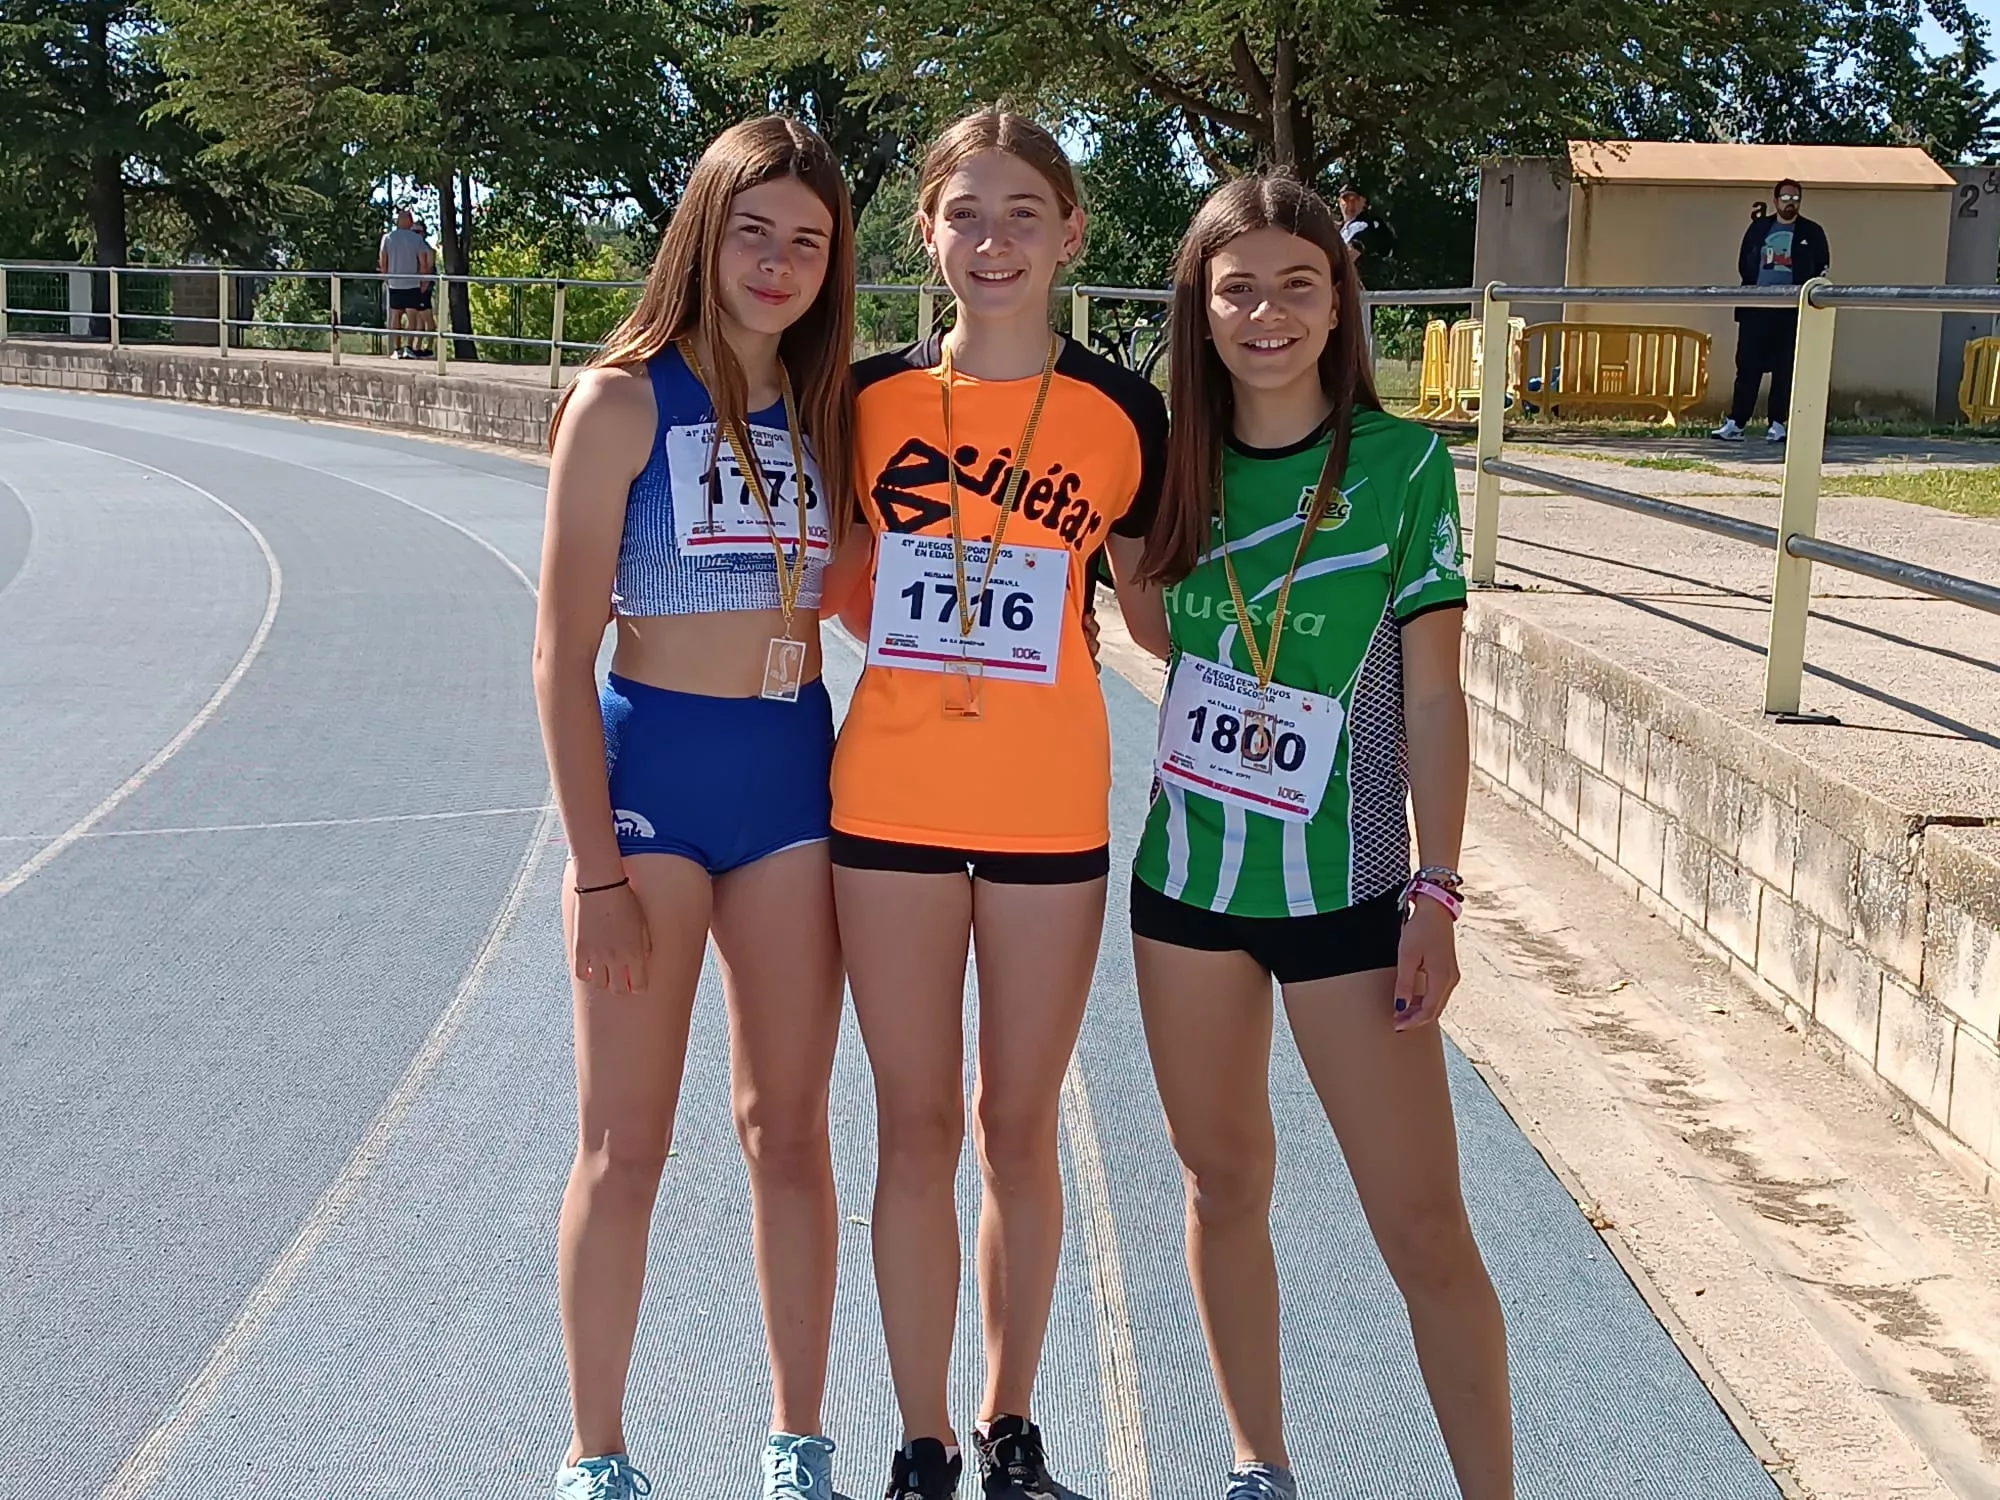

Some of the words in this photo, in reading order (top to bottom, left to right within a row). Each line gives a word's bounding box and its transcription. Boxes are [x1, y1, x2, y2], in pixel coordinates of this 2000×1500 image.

[1500, 174, 1514, 208] 1
[1959, 184, 1980, 218] 2
[699, 466, 818, 510] 1773
[914, 549, 928, 557] EN
[917, 541, 953, 551] JUEGOS
[901, 580, 1034, 632] 1716
[1187, 705, 1307, 772] 1800
